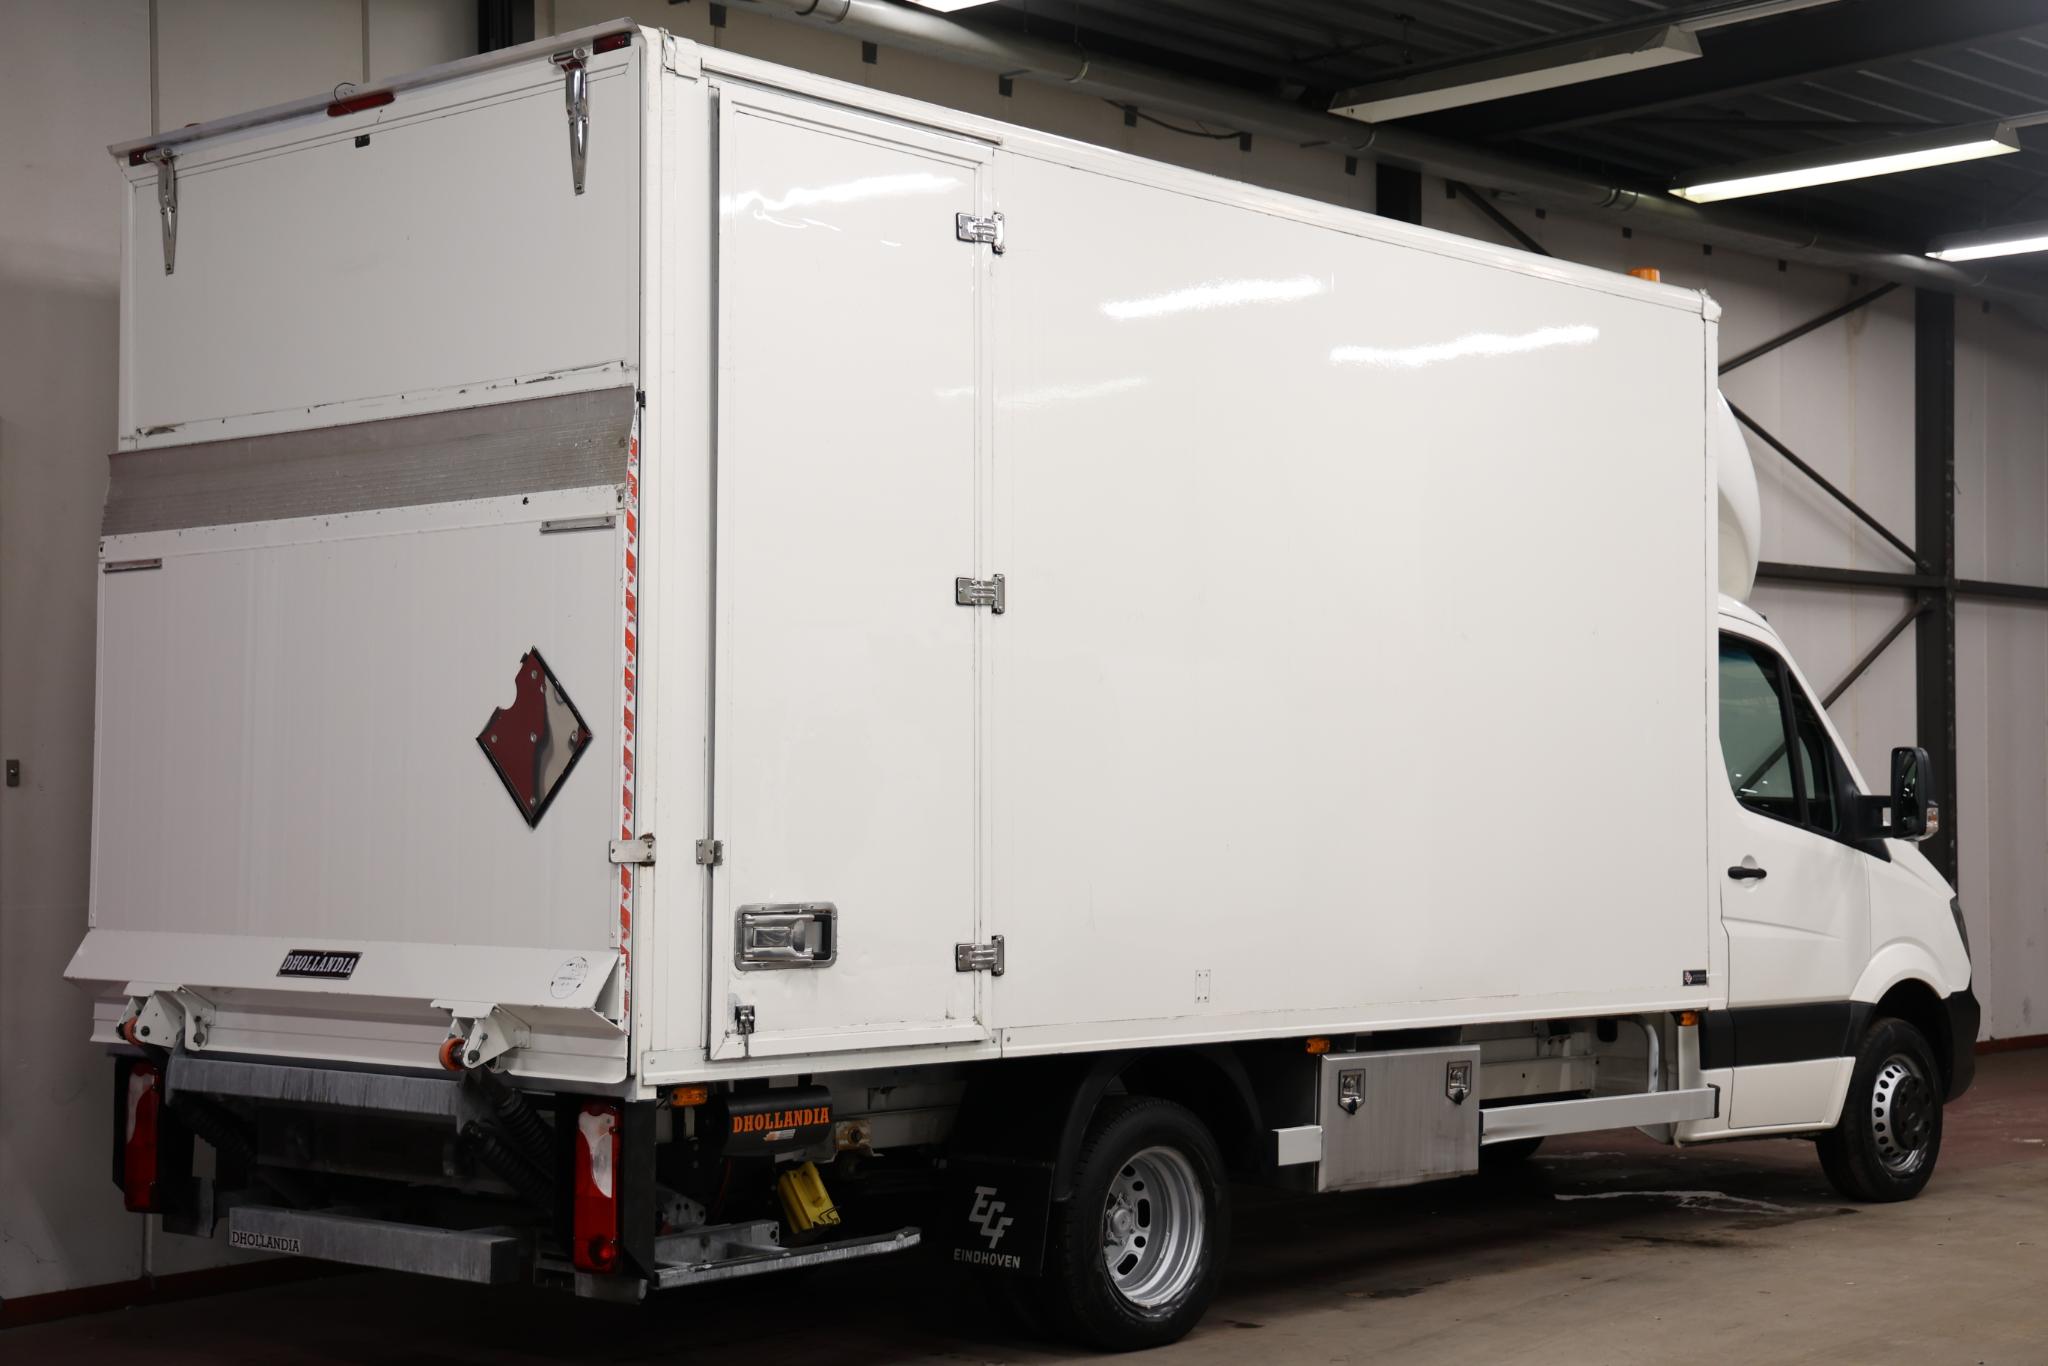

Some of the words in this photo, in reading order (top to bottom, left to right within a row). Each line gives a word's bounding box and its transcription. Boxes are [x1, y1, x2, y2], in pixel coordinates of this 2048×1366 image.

[281, 954, 357, 974] DHOLLANDIA
[733, 1106, 830, 1134] DHOLLANDIA
[231, 1231, 300, 1253] DHOLLANDIA
[953, 1247, 1021, 1269] EINDHOVEN
